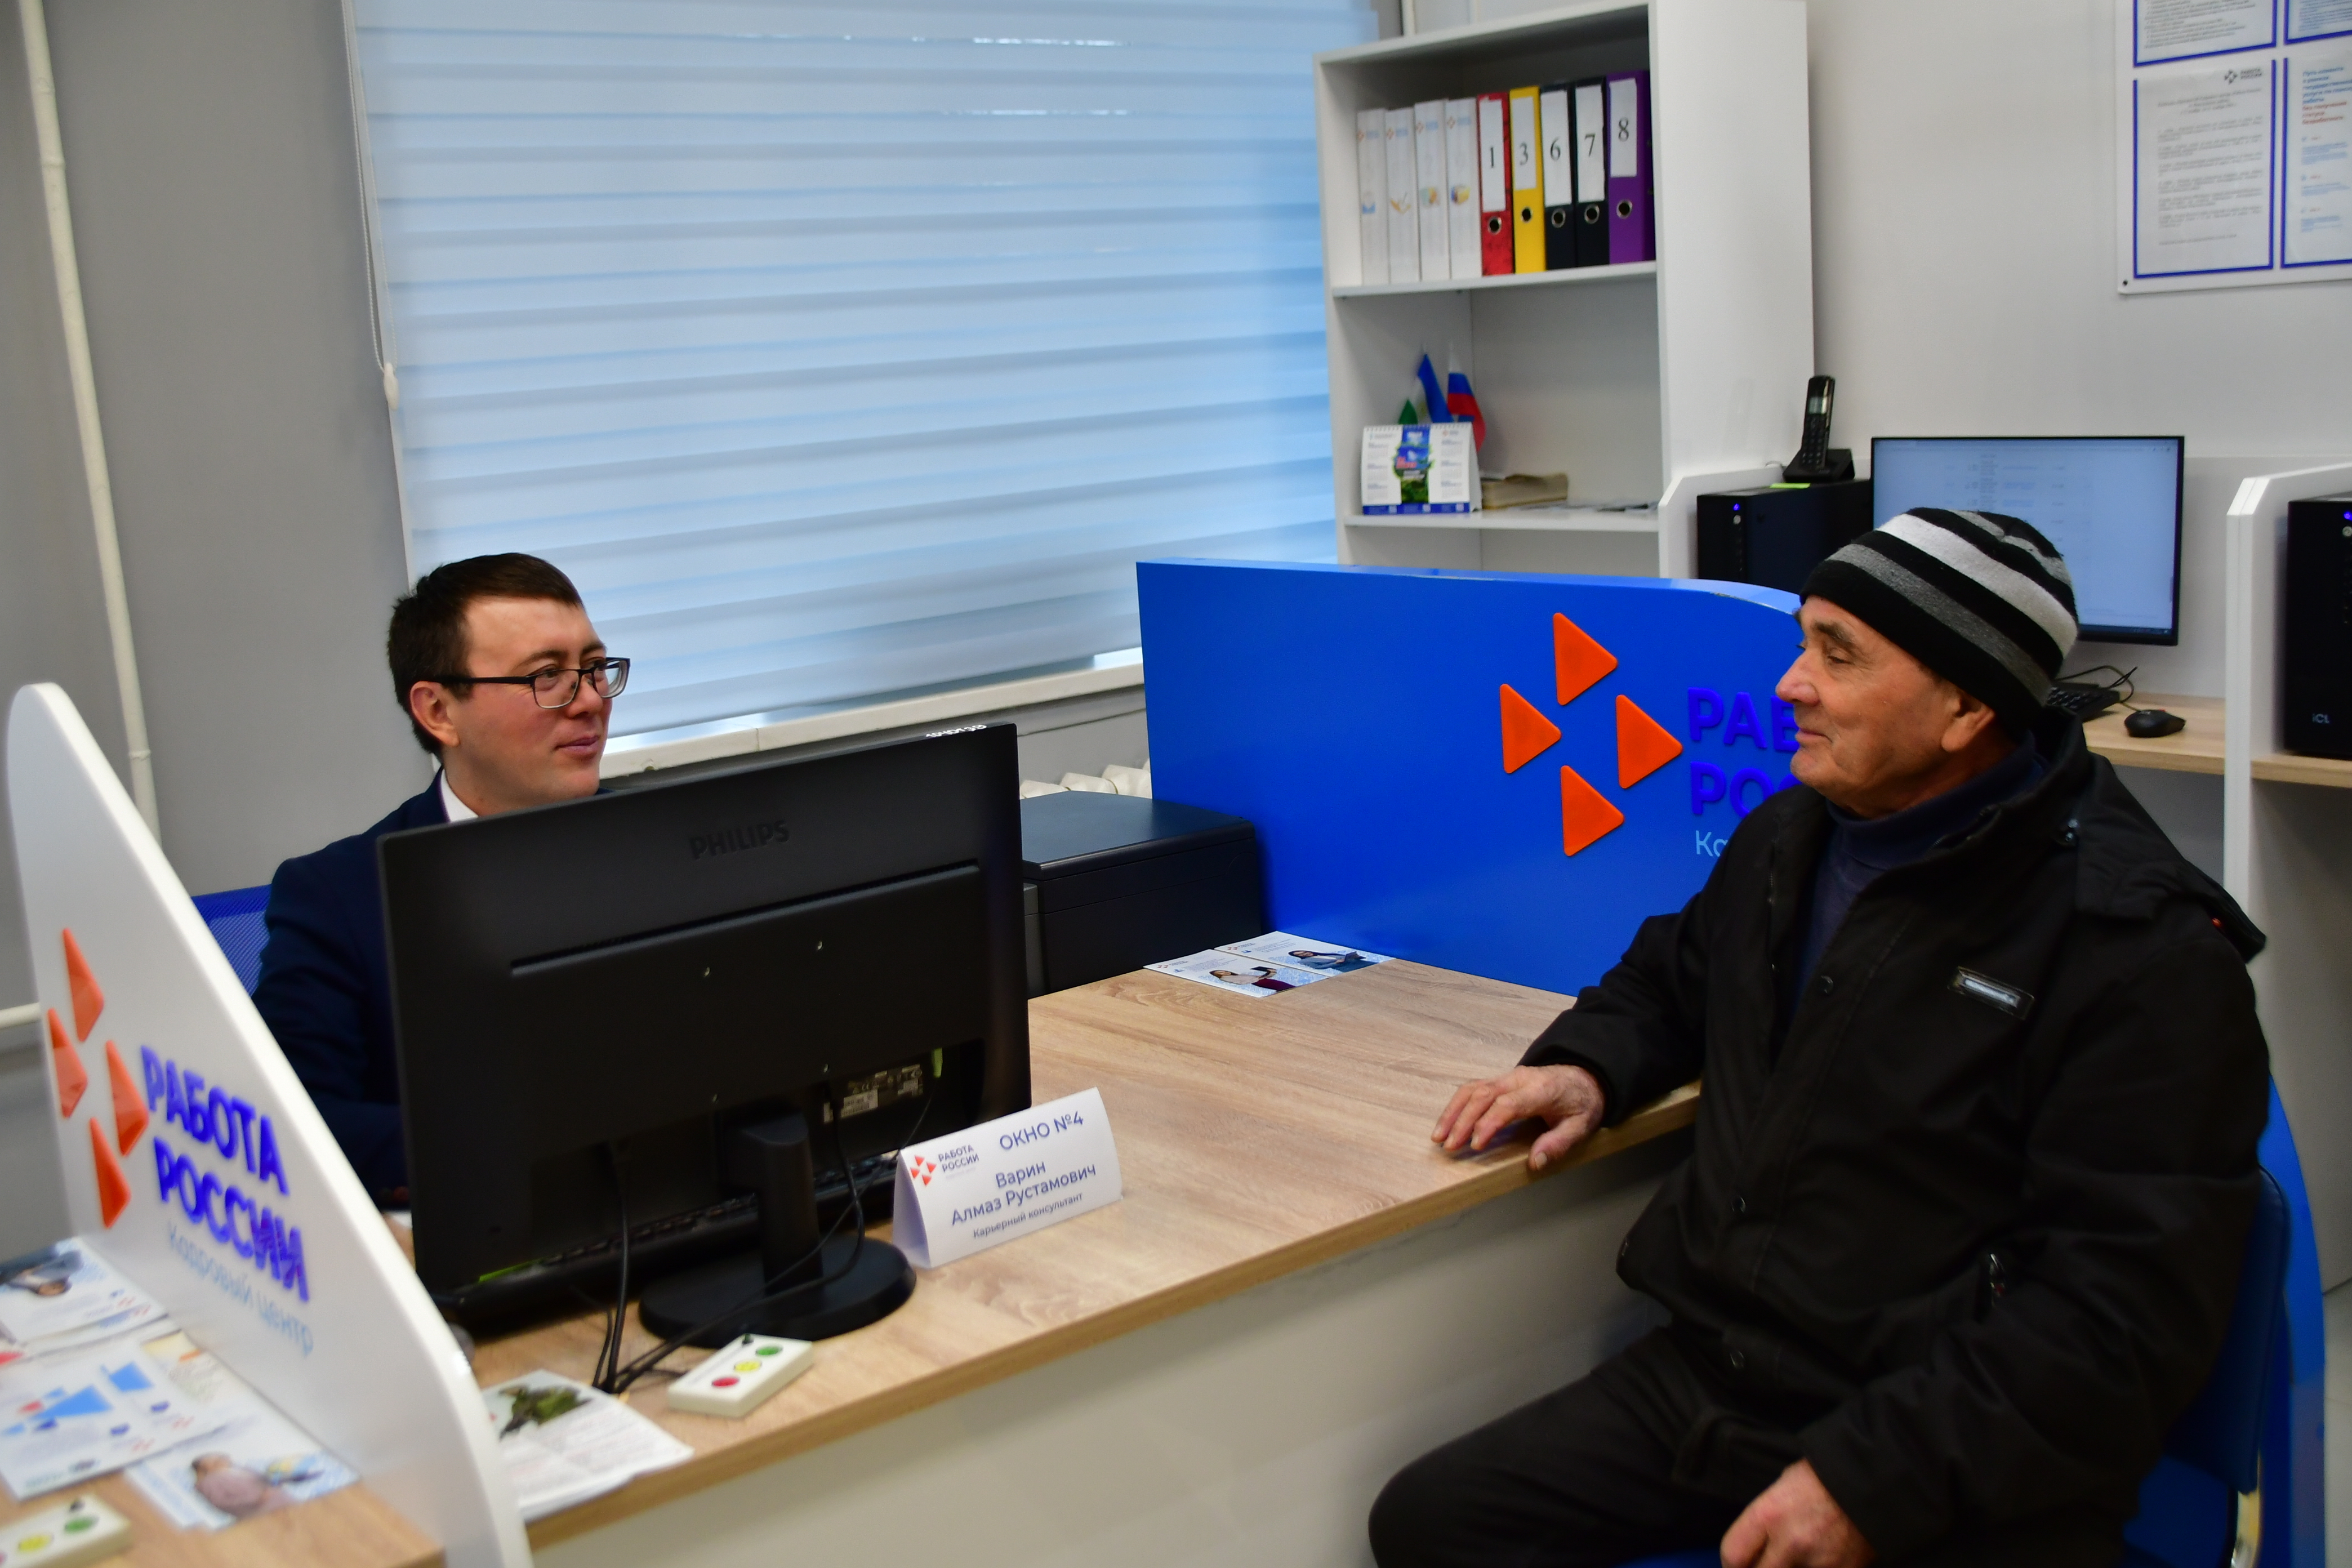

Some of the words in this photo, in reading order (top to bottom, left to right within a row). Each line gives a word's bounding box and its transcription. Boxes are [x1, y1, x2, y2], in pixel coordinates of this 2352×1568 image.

[1618, 117, 1629, 141] 8
[1490, 146, 1495, 168] 1
[1520, 142, 1529, 166] 3
[1550, 137, 1561, 161] 6
[1585, 133, 1596, 157] 7
[1688, 687, 1800, 752] РАБ
[688, 819, 790, 861] PHILIPS
[141, 1044, 290, 1197] РАБОТА
[999, 1122, 1050, 1150] ОКНО
[1053, 1111, 1084, 1133] №4
[938, 1144, 974, 1162] РАБОТА
[942, 1153, 979, 1173] РОССИИ
[995, 1161, 1046, 1189] Варин
[952, 1197, 1002, 1226] Алмаз
[1005, 1164, 1096, 1207] Рустамович
[153, 1135, 309, 1302] РОССИИ
[973, 1211, 1027, 1239] Карьерный
[1028, 1192, 1083, 1219] консультант
